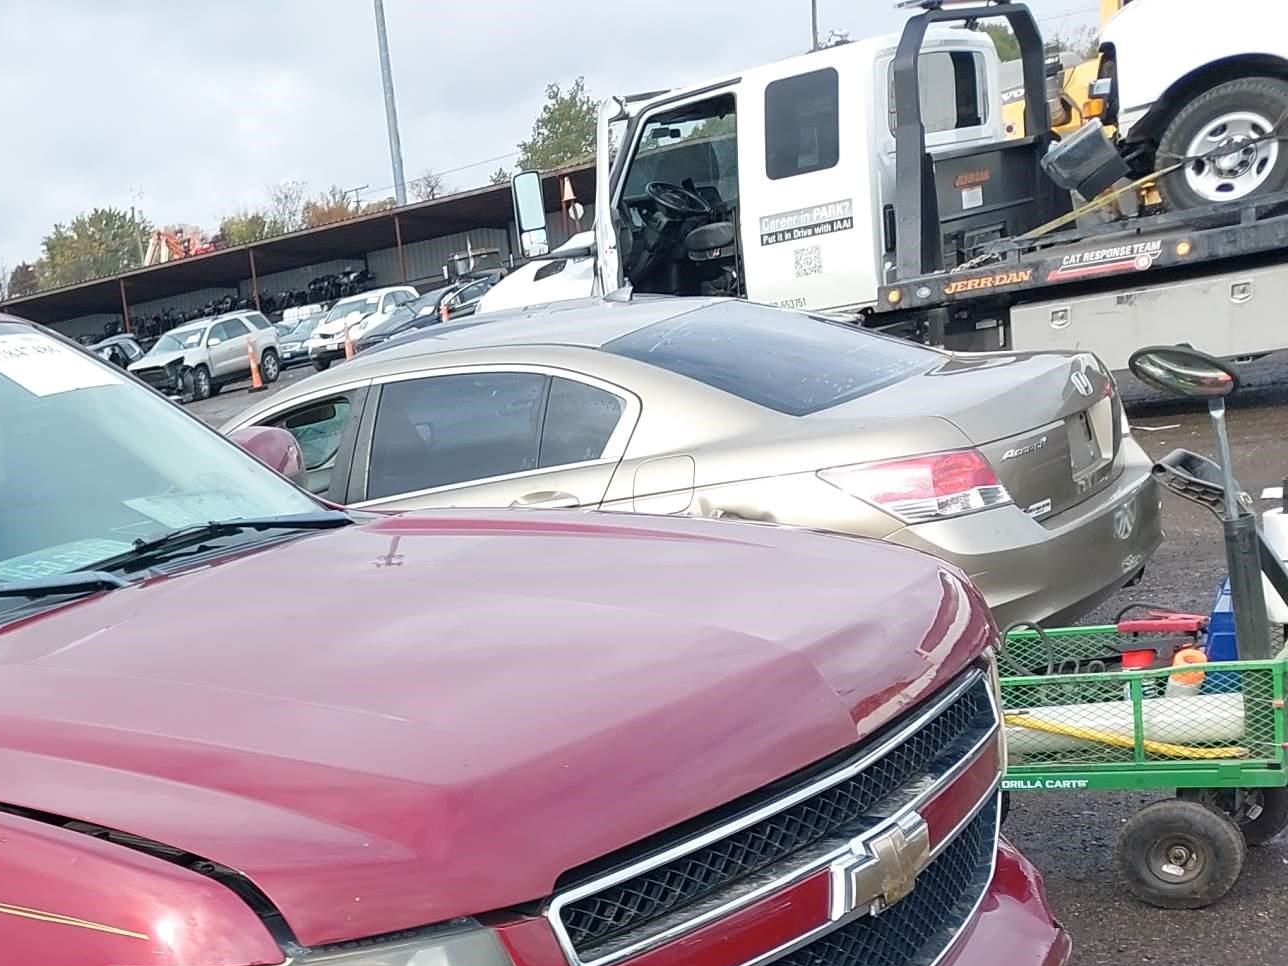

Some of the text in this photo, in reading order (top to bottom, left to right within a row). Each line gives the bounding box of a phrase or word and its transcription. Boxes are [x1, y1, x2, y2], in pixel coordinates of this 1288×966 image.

[762, 202, 850, 231] Career in PARK?
[763, 234, 776, 244] Put
[784, 232, 792, 240] in
[793, 227, 813, 239] Drive
[814, 222, 832, 235] with
[1063, 240, 1162, 266] CAT RESPONSE TEAM
[943, 269, 1032, 295] JERR-DAN
[1001, 779, 1087, 789] ORILLA CARTS
